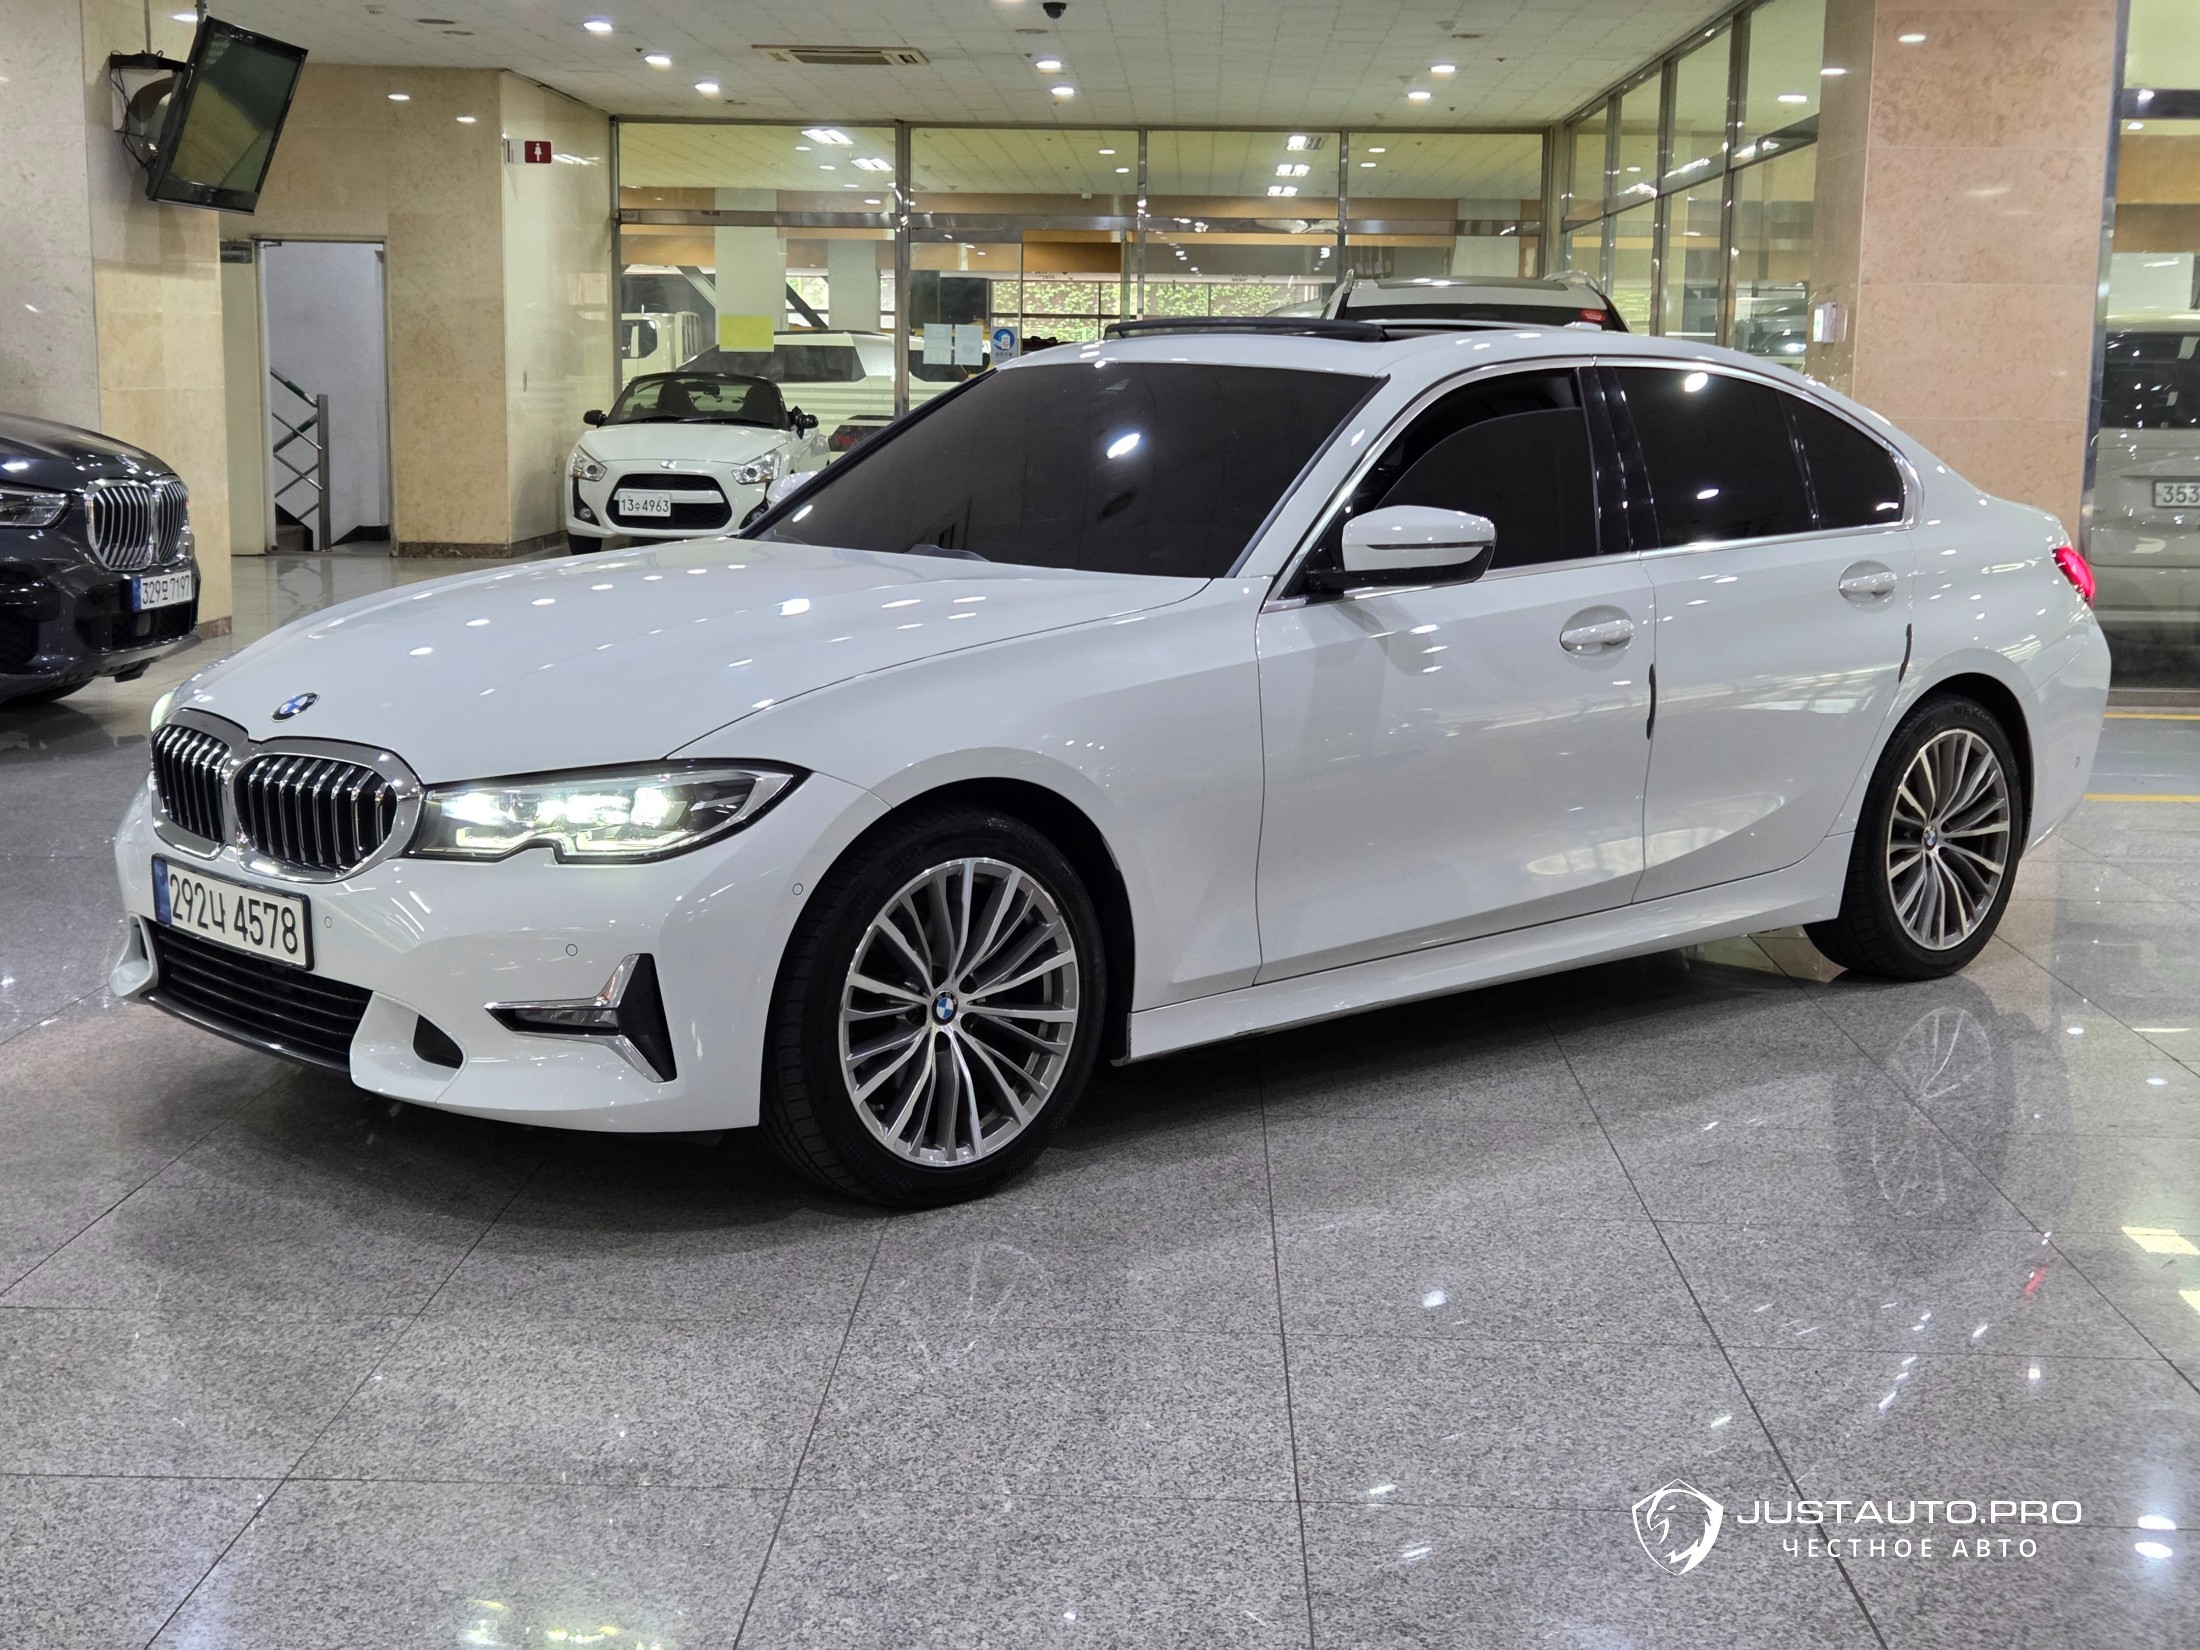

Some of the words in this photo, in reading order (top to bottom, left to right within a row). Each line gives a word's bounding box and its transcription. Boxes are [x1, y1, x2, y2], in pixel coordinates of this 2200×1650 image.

[142, 580, 168, 604] 329모
[170, 574, 190, 600] 7197
[169, 873, 226, 933] 292나
[233, 895, 298, 954] 4578
